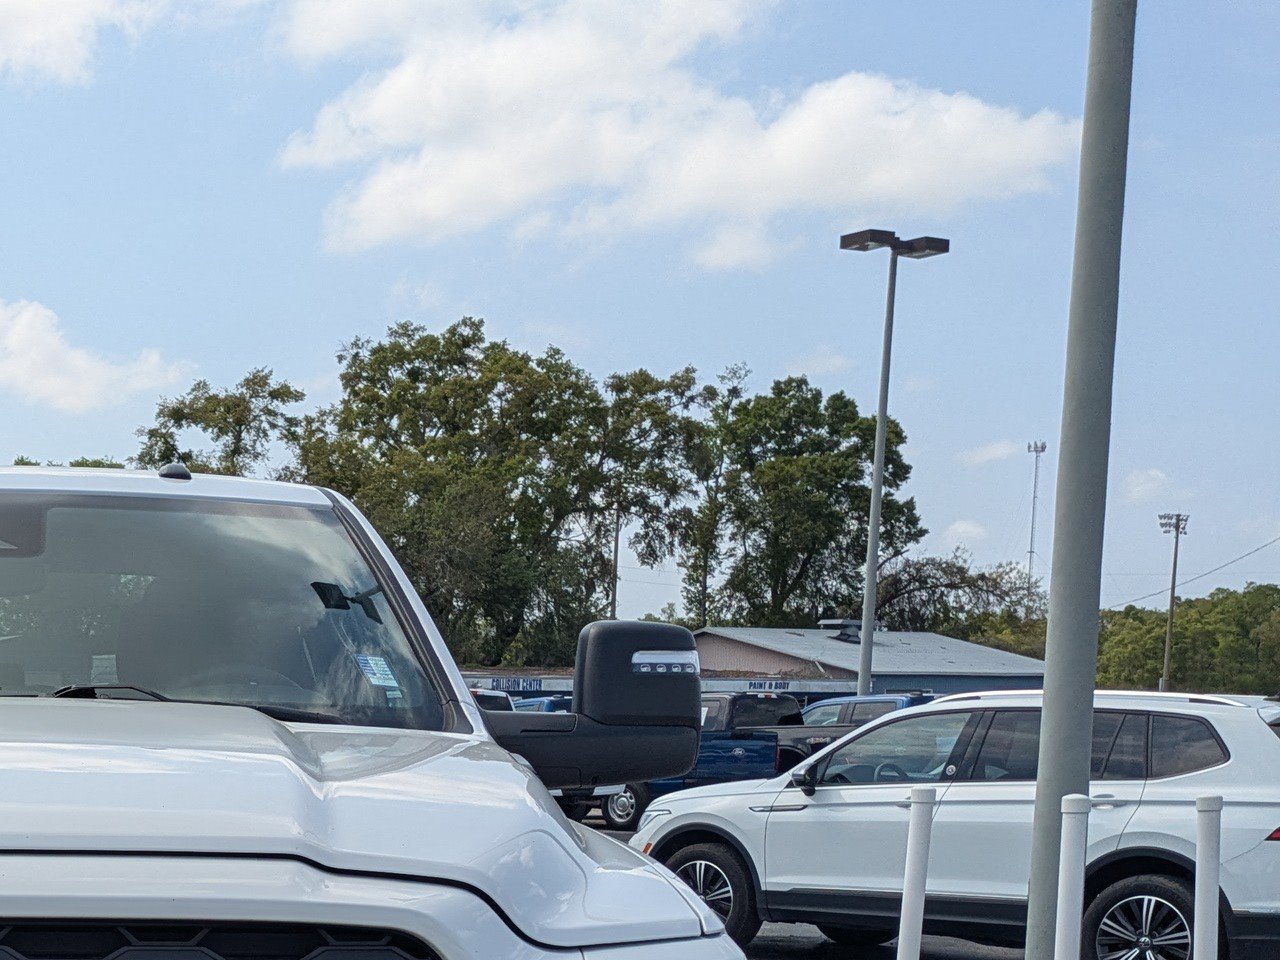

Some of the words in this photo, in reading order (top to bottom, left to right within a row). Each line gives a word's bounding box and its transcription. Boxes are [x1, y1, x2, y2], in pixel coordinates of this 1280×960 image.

[491, 678, 521, 691] COLLISION
[522, 678, 542, 691] CENTER
[748, 681, 767, 690] PAINT
[774, 681, 790, 690] BODY
